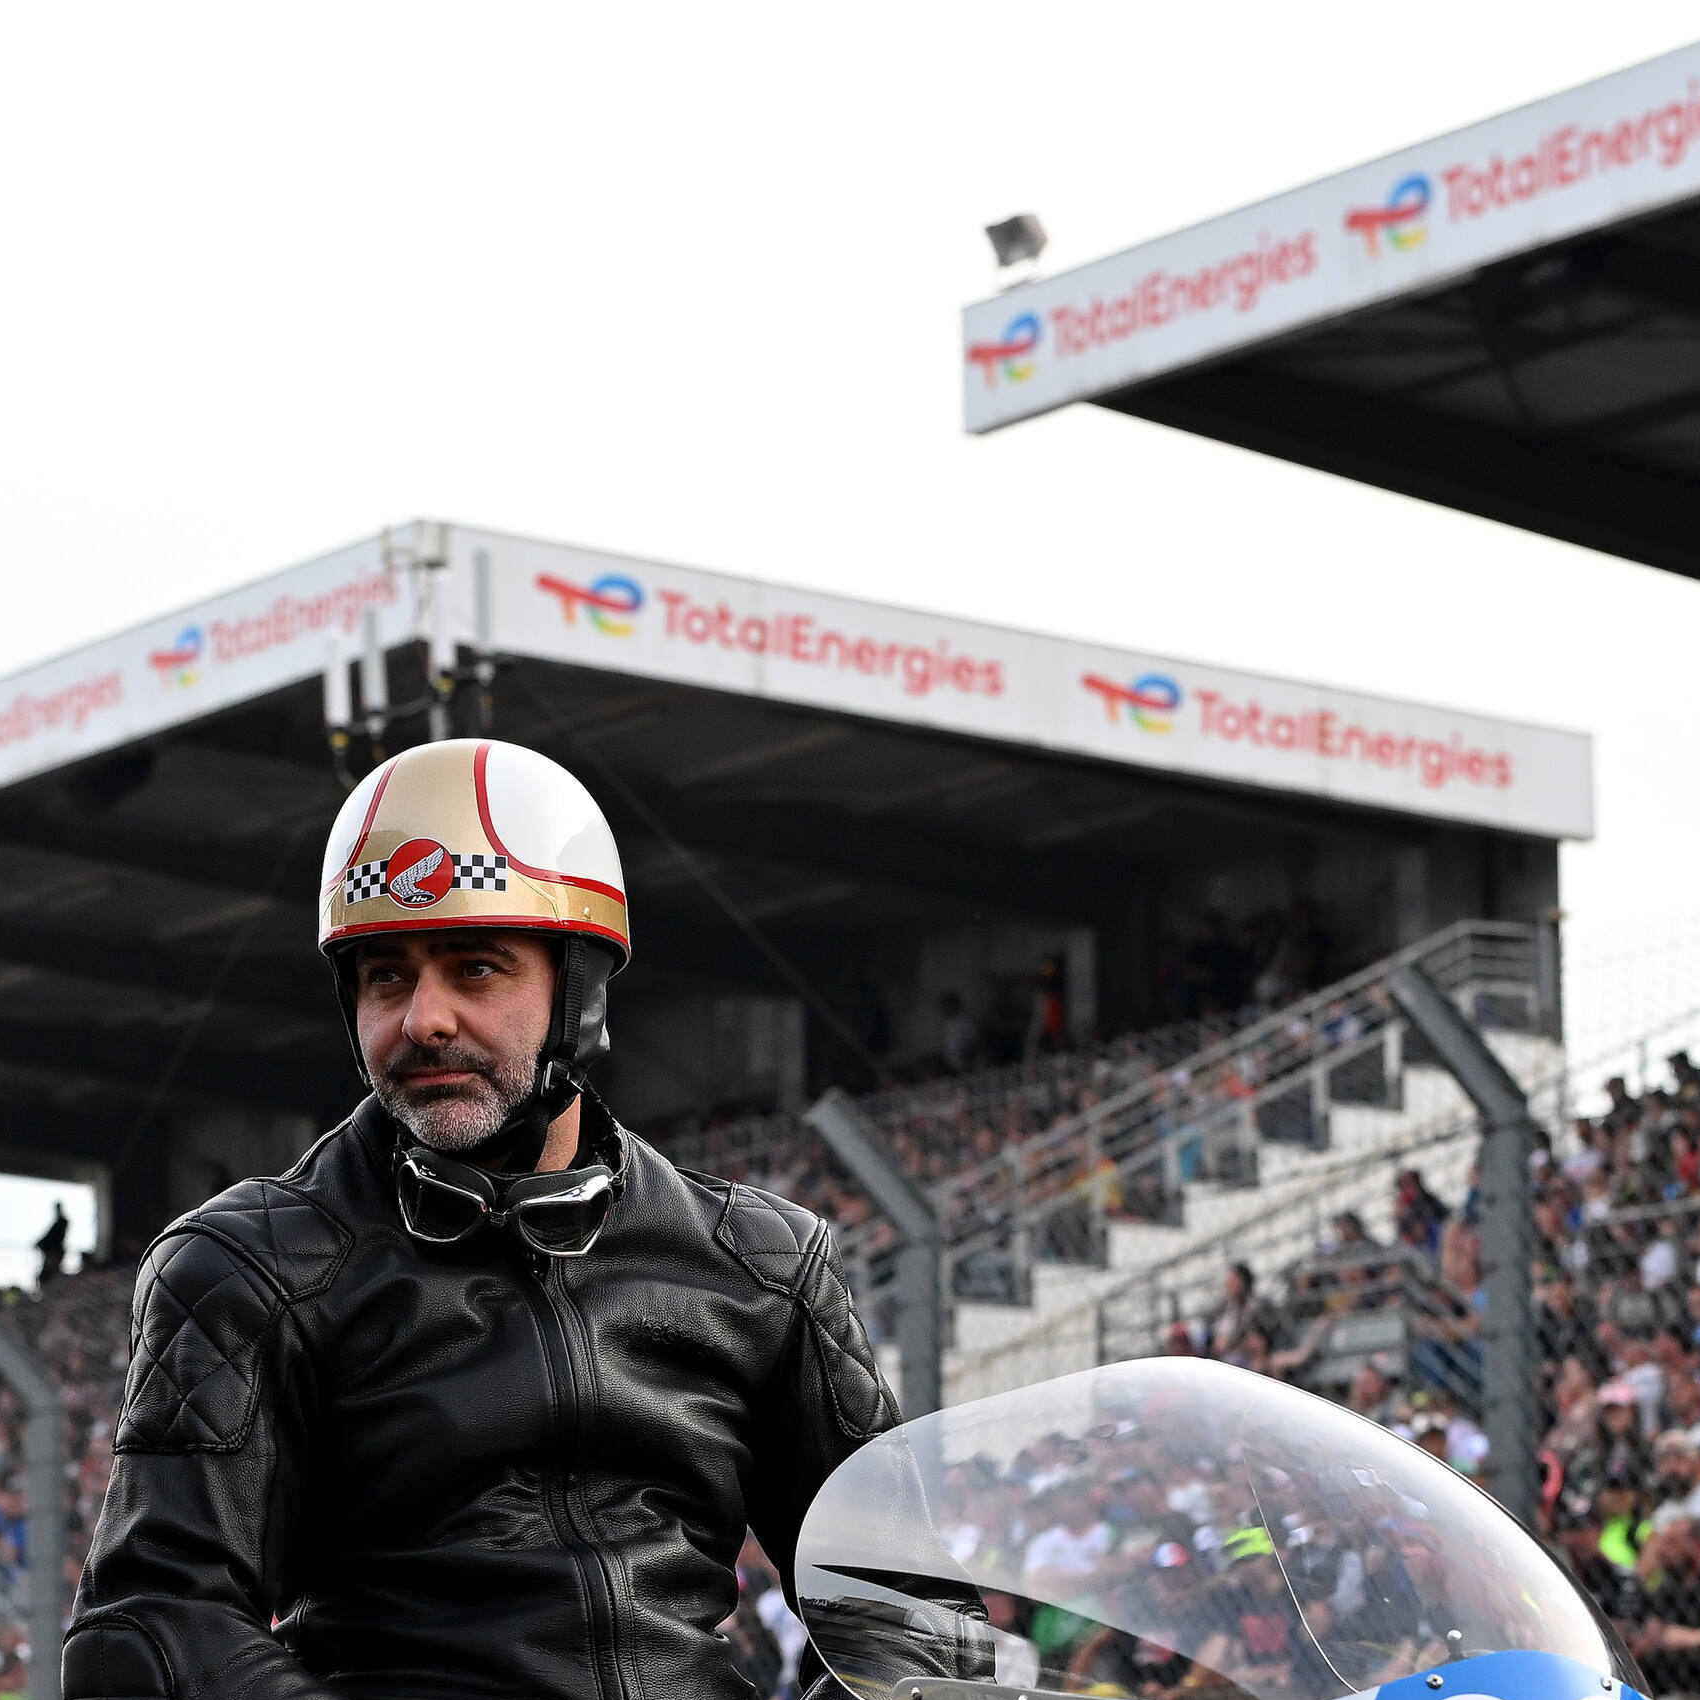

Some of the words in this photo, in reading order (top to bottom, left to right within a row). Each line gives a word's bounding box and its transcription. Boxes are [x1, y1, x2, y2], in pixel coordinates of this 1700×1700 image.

[1048, 227, 1318, 360] TotalEnergies
[656, 590, 1005, 699] TotalEnergies
[1196, 690, 1513, 791] TotalEnergies
